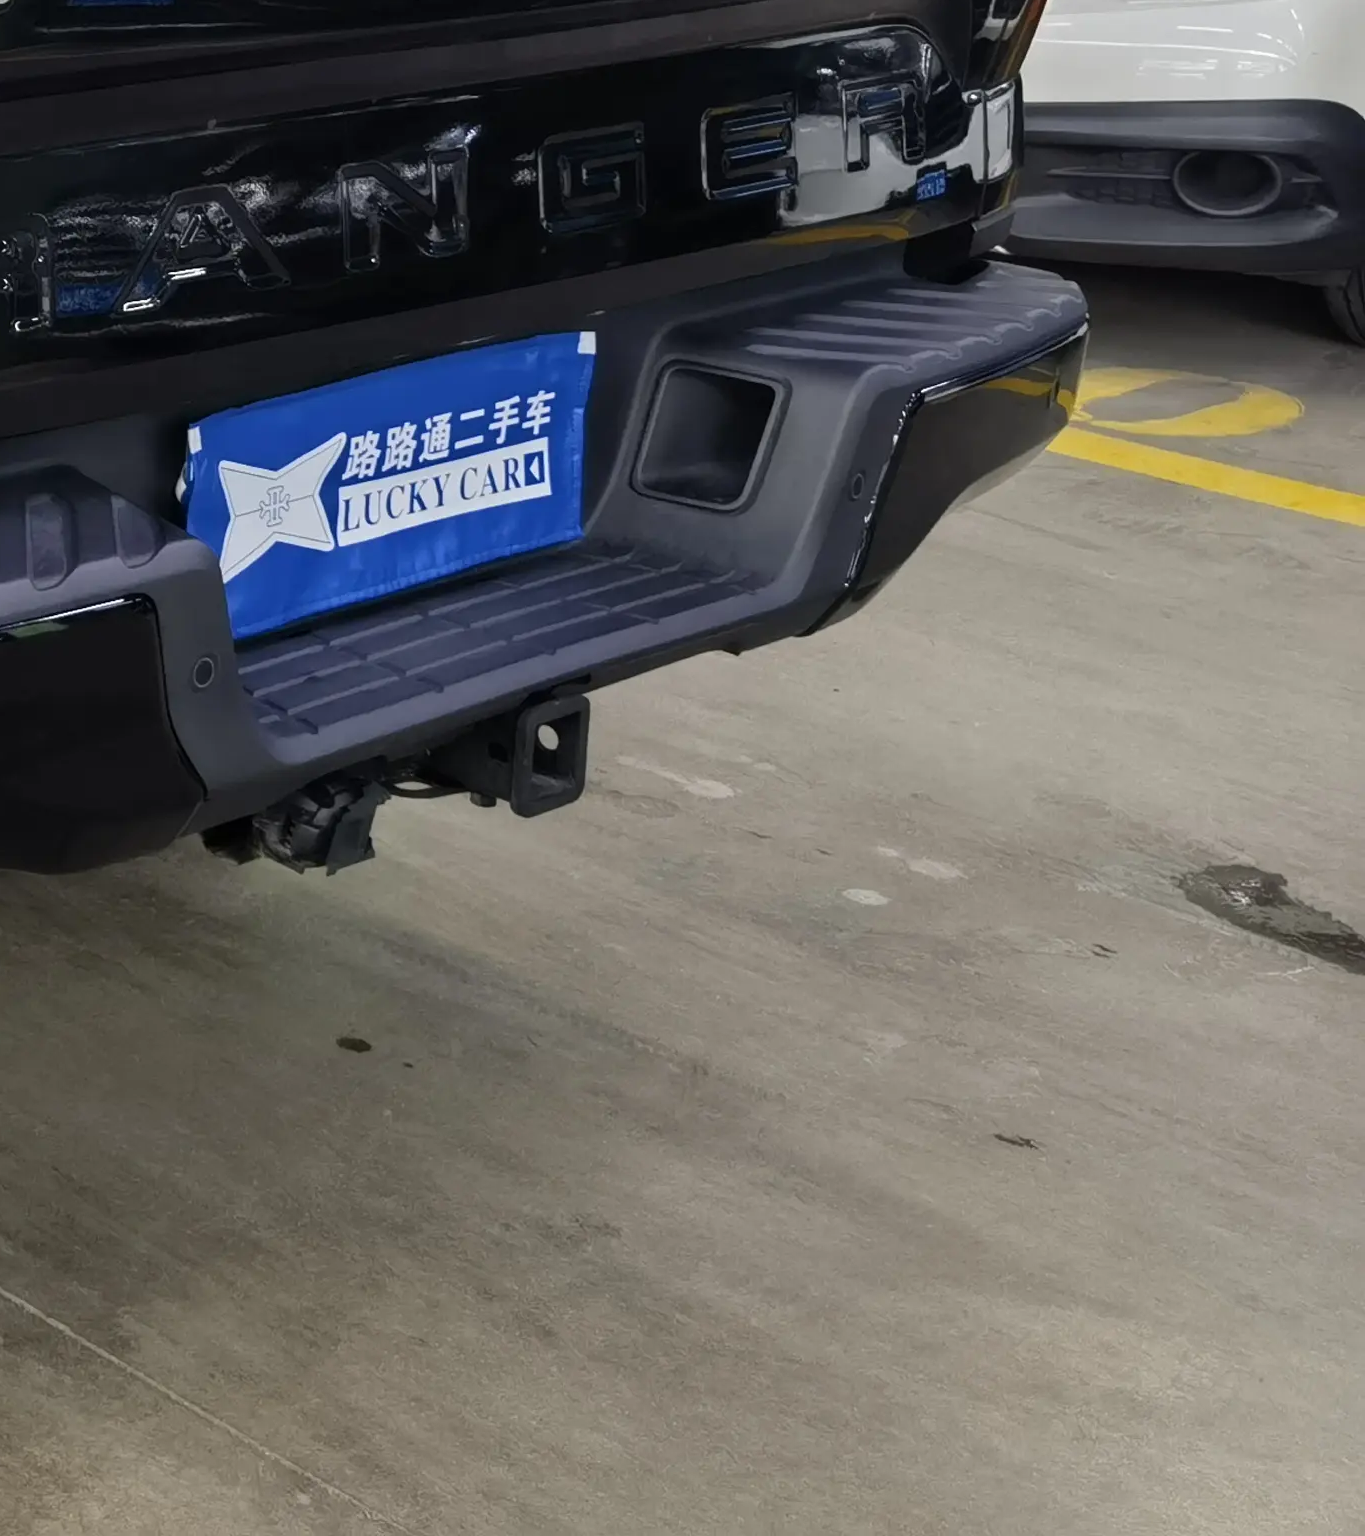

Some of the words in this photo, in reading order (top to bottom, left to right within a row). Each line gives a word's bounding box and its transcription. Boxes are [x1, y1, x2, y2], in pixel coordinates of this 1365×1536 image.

[341, 390, 556, 481] 路路通二手车
[341, 473, 450, 533] LUCKY
[459, 457, 522, 502] CAR
